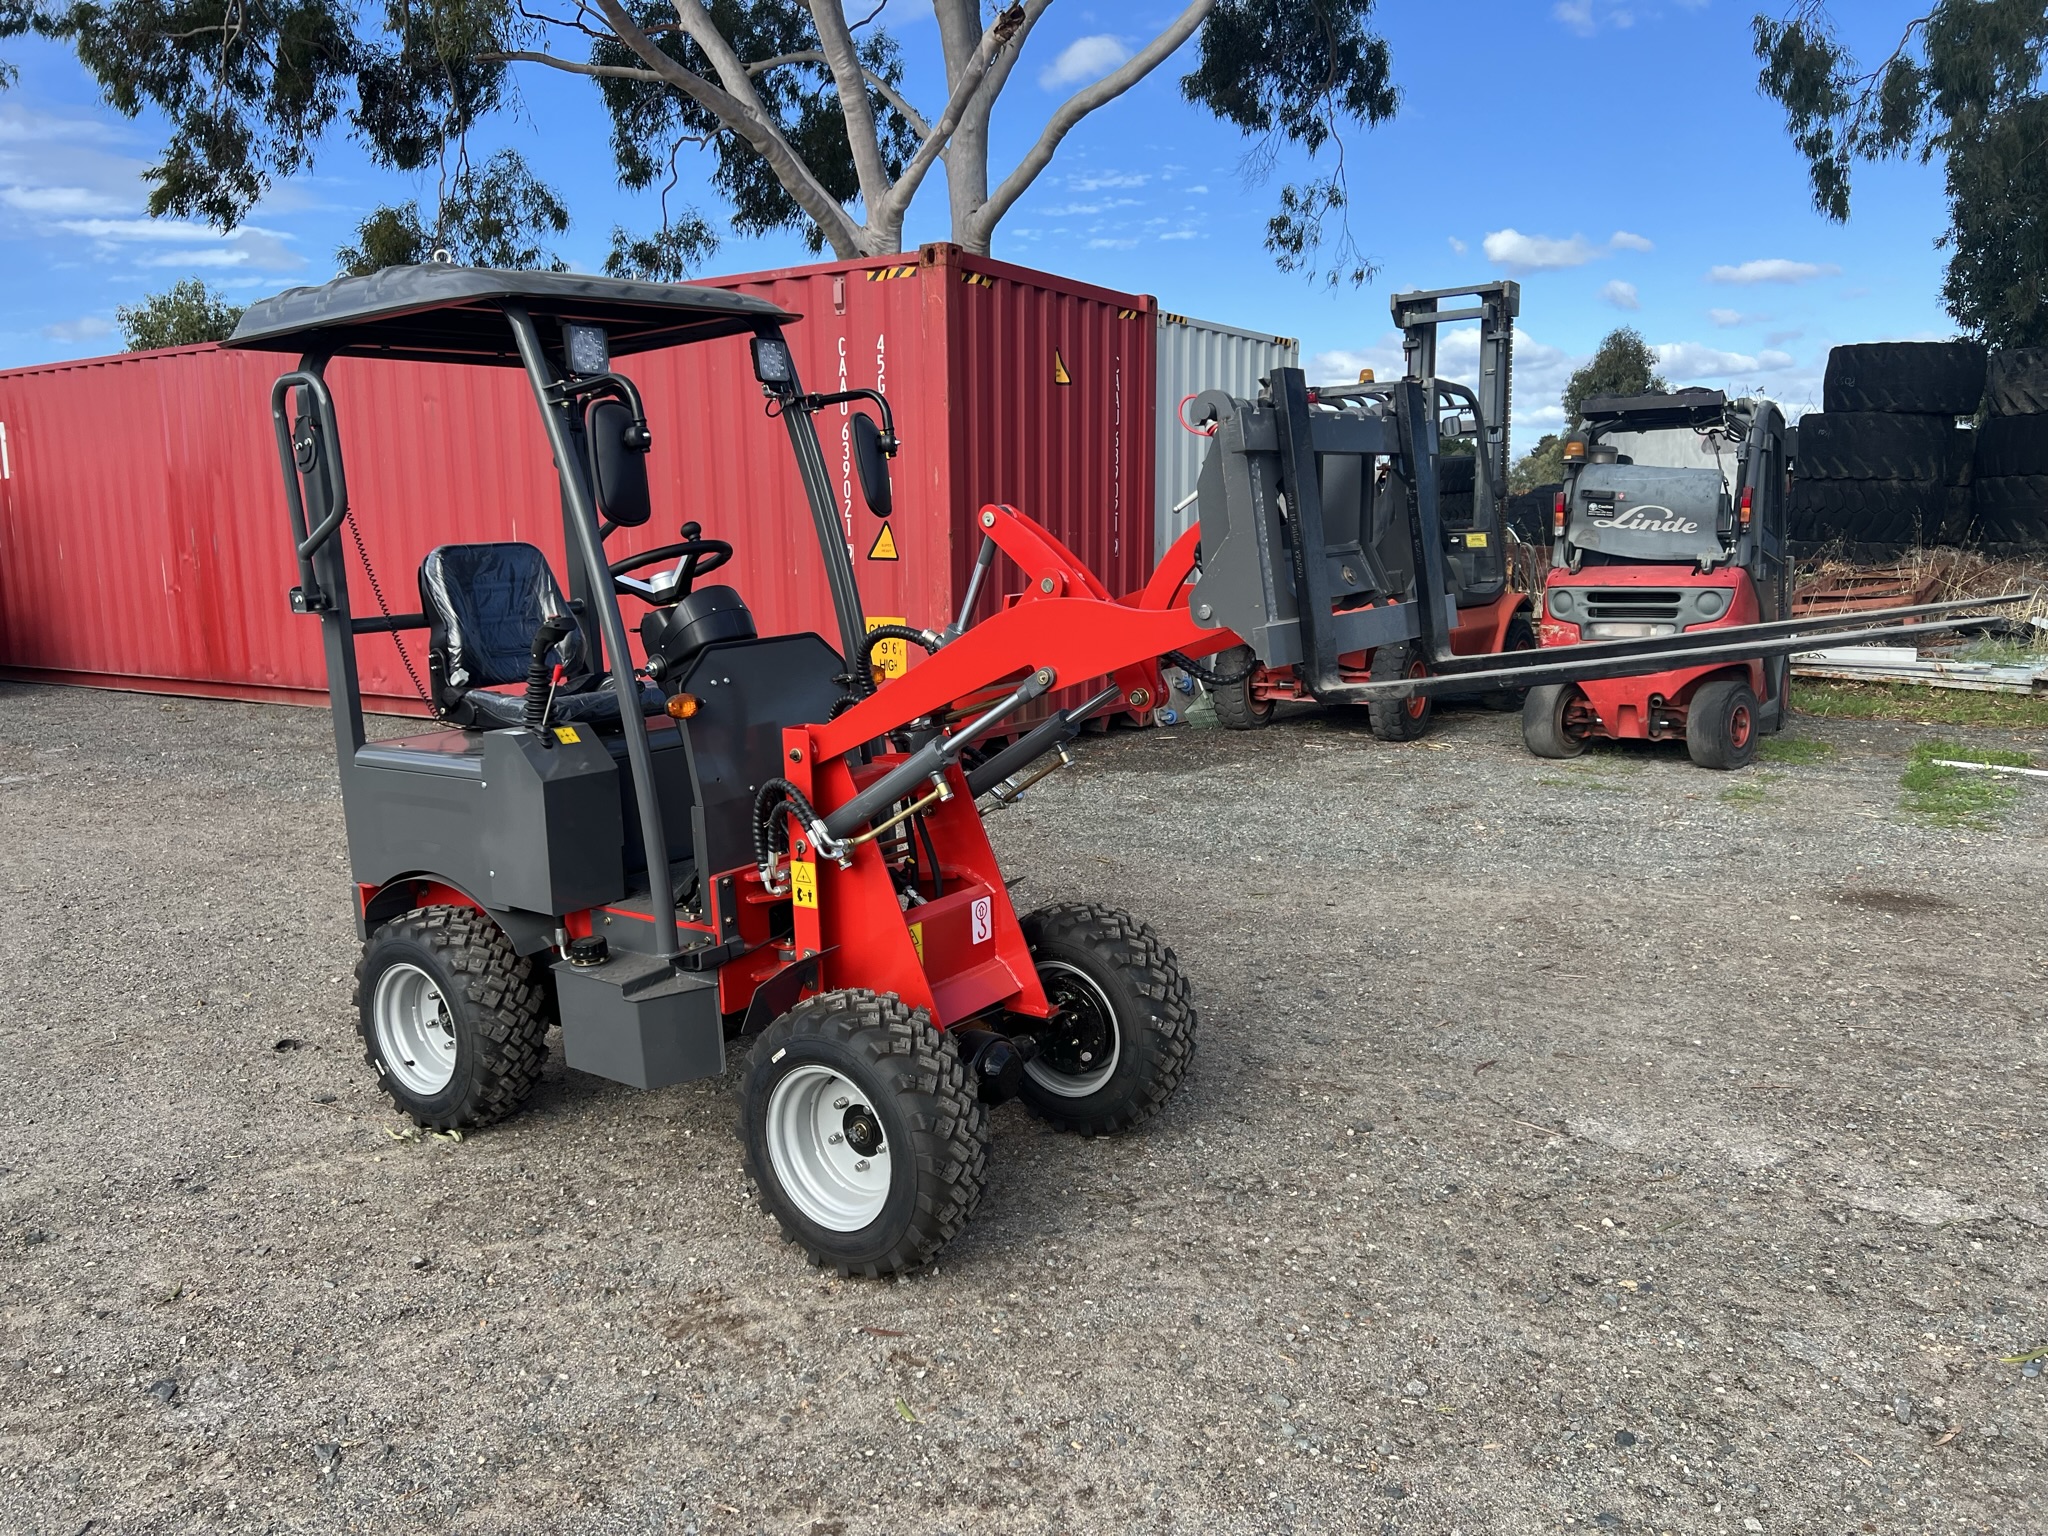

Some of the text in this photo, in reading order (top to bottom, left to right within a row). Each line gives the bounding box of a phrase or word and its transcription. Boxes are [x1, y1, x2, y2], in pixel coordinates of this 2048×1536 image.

[838, 336, 848, 416] CAAU
[877, 334, 886, 396] 45G
[841, 422, 852, 537] 639021
[1593, 504, 1698, 534] Linde
